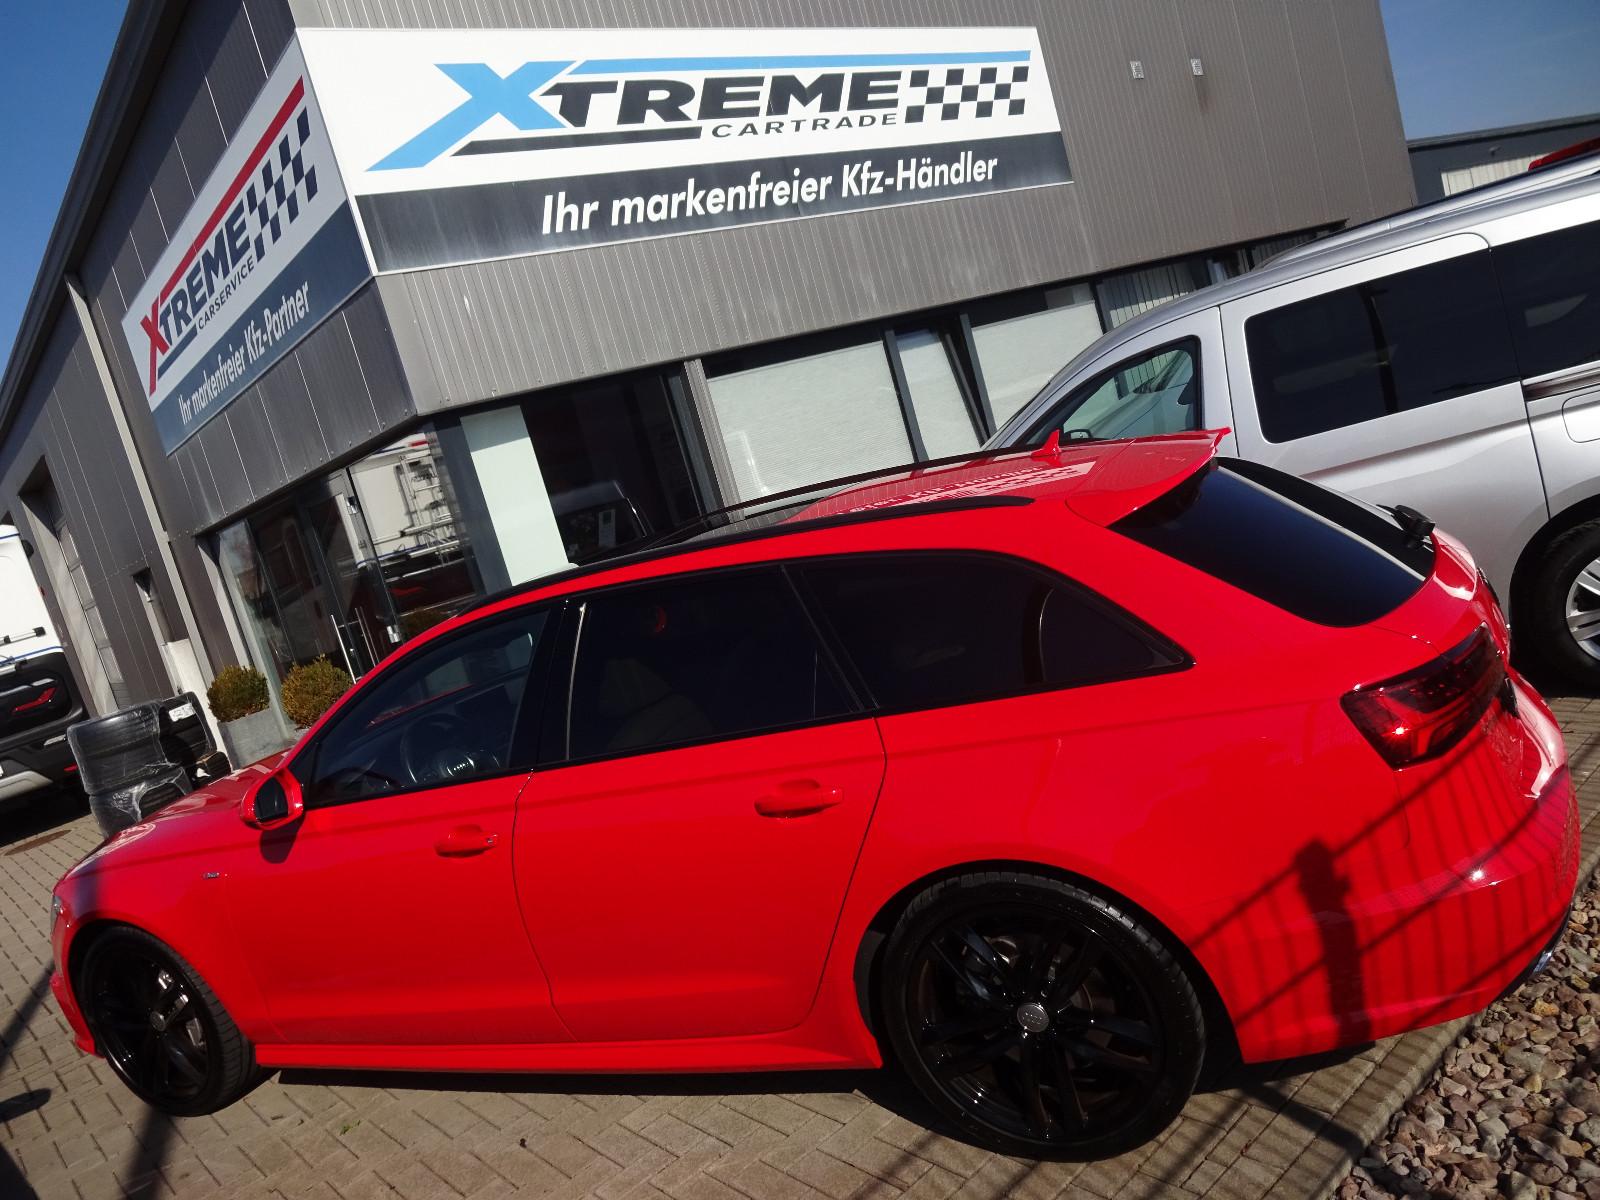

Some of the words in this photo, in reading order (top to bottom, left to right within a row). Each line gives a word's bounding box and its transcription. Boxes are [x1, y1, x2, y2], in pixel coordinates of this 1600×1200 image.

[365, 60, 902, 172] XTREME
[711, 112, 897, 138] CARTRADE
[542, 191, 599, 235] Ihr
[611, 167, 833, 227] markenfreier
[841, 150, 998, 198] Kfz-Händler
[140, 198, 251, 398] XTREME
[198, 255, 255, 331] CARSERVICE
[178, 394, 193, 426] Ihr
[191, 343, 247, 415] markenfreier
[243, 280, 310, 365] Kfz-Partner
